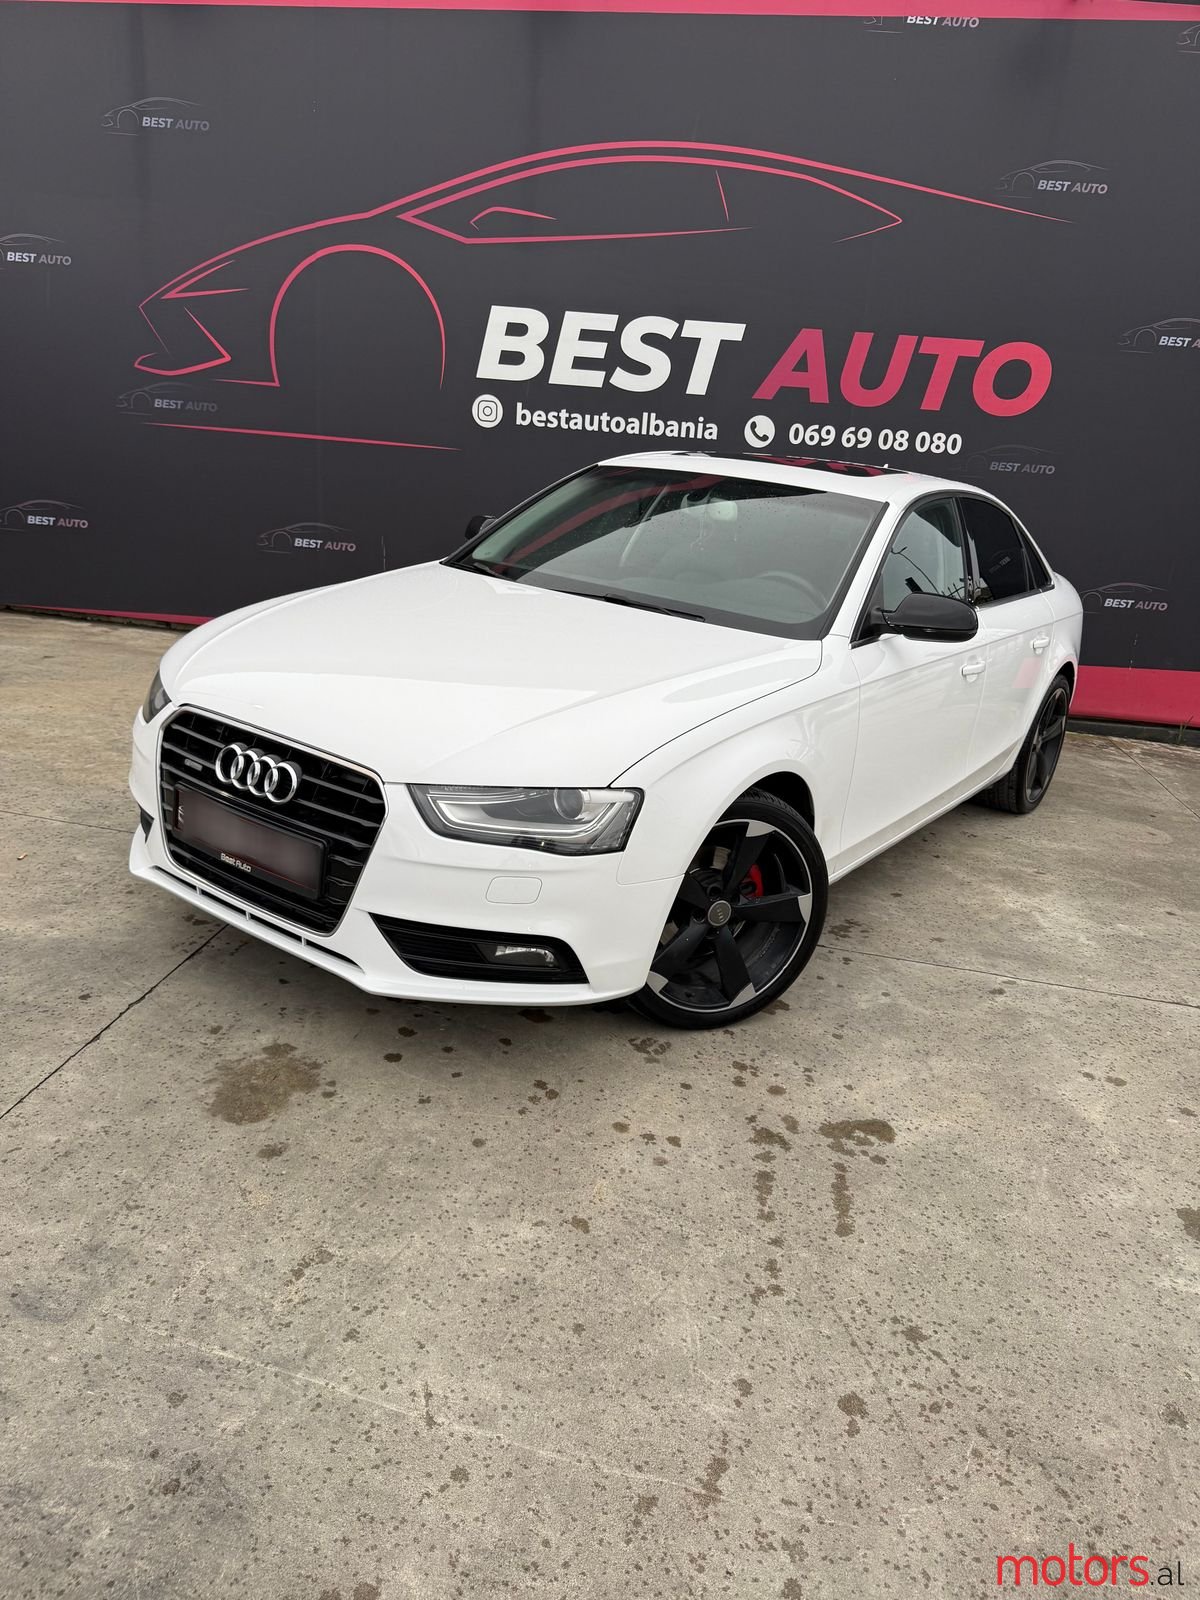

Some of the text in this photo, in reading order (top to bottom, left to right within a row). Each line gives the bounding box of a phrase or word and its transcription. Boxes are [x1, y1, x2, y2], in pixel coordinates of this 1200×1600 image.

[906, 15, 980, 28] BEST AUTO
[142, 116, 210, 131] BEST AUTO
[1037, 179, 1108, 194] BEST AUTO
[6, 251, 72, 266] BEST AUTO
[1158, 335, 1192, 347] BEST
[475, 304, 1053, 417] BEST AUTO
[154, 398, 218, 413] BEST AUTO
[515, 402, 718, 440] bestautoalbania
[788, 422, 962, 455] 069 69 08 080
[989, 461, 1056, 475] BEST AUTO
[27, 515, 89, 529] BEST AUTO
[294, 537, 356, 552] BEST AUTO
[1104, 598, 1168, 611] BEST AUTO
[220, 852, 252, 873] Best Auto
